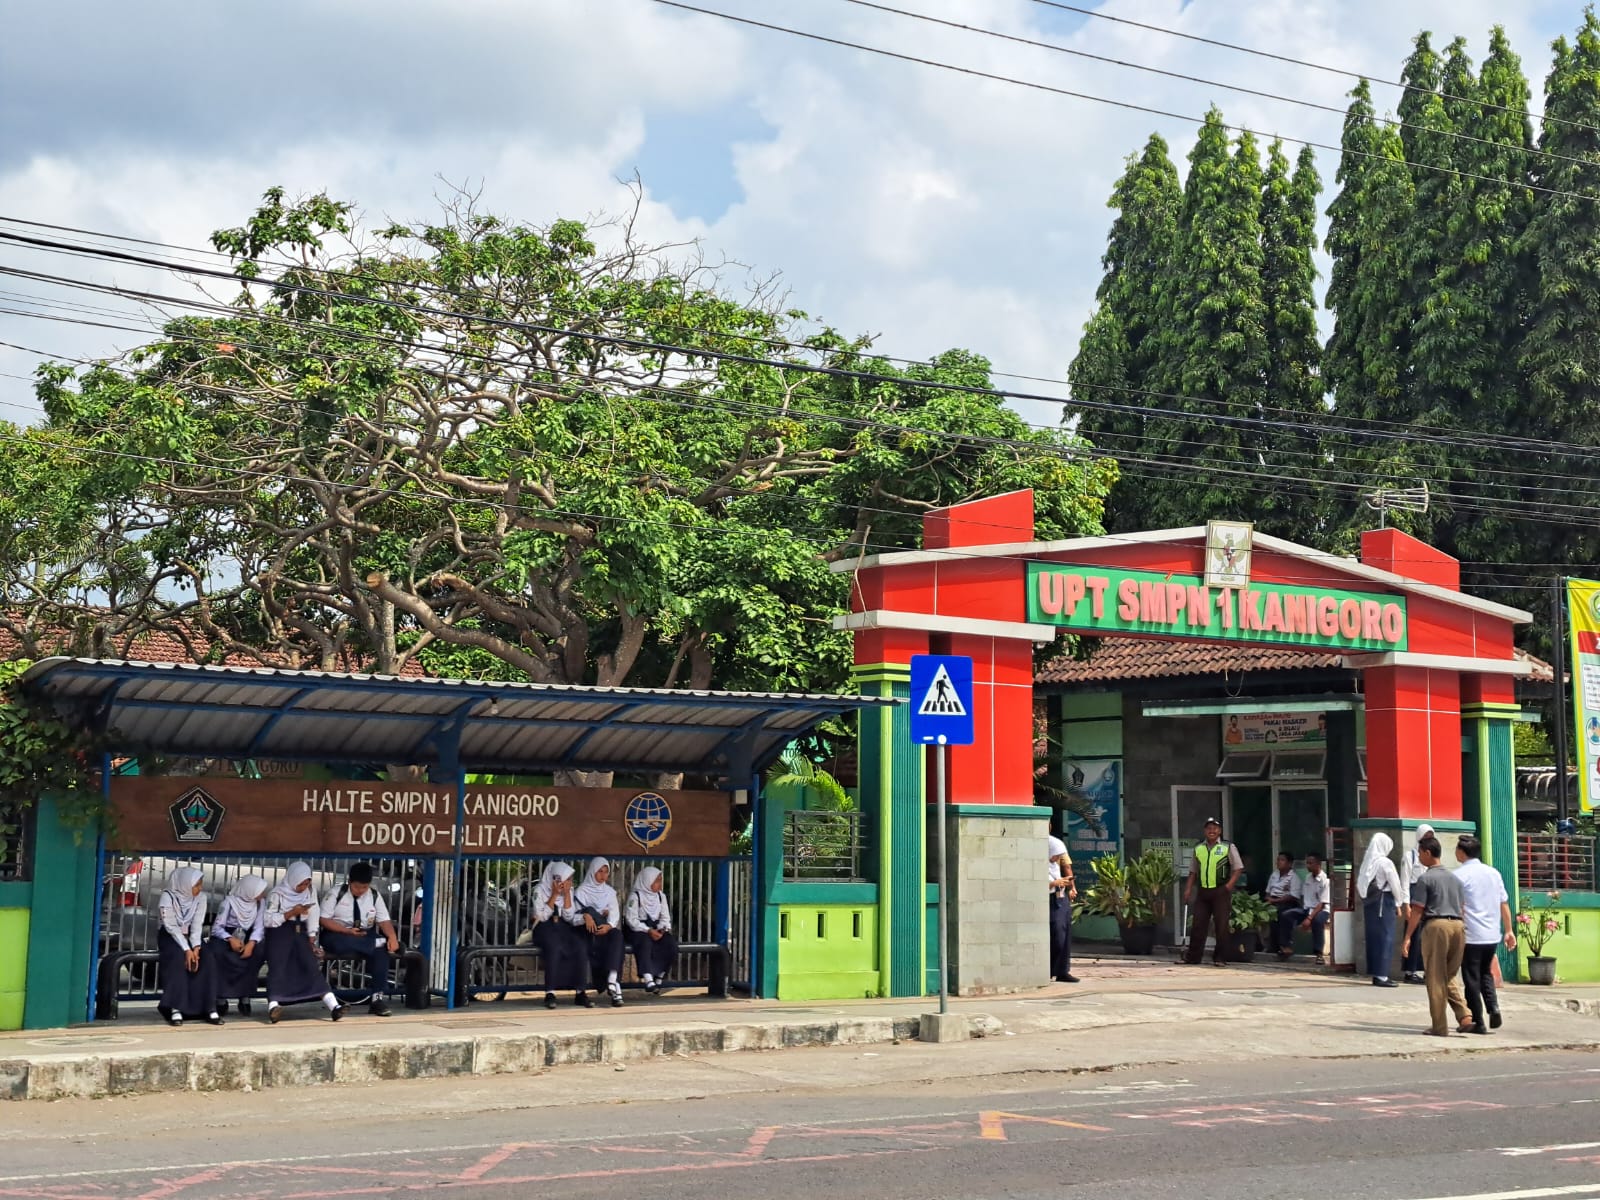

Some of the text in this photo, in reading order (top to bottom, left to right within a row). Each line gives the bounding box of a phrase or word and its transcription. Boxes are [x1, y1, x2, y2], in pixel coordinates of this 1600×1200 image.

[1039, 571, 1404, 643] UPT SMPN 1 KANIGORO
[302, 789, 560, 817] HALTE SMPN 1 KANIGORO
